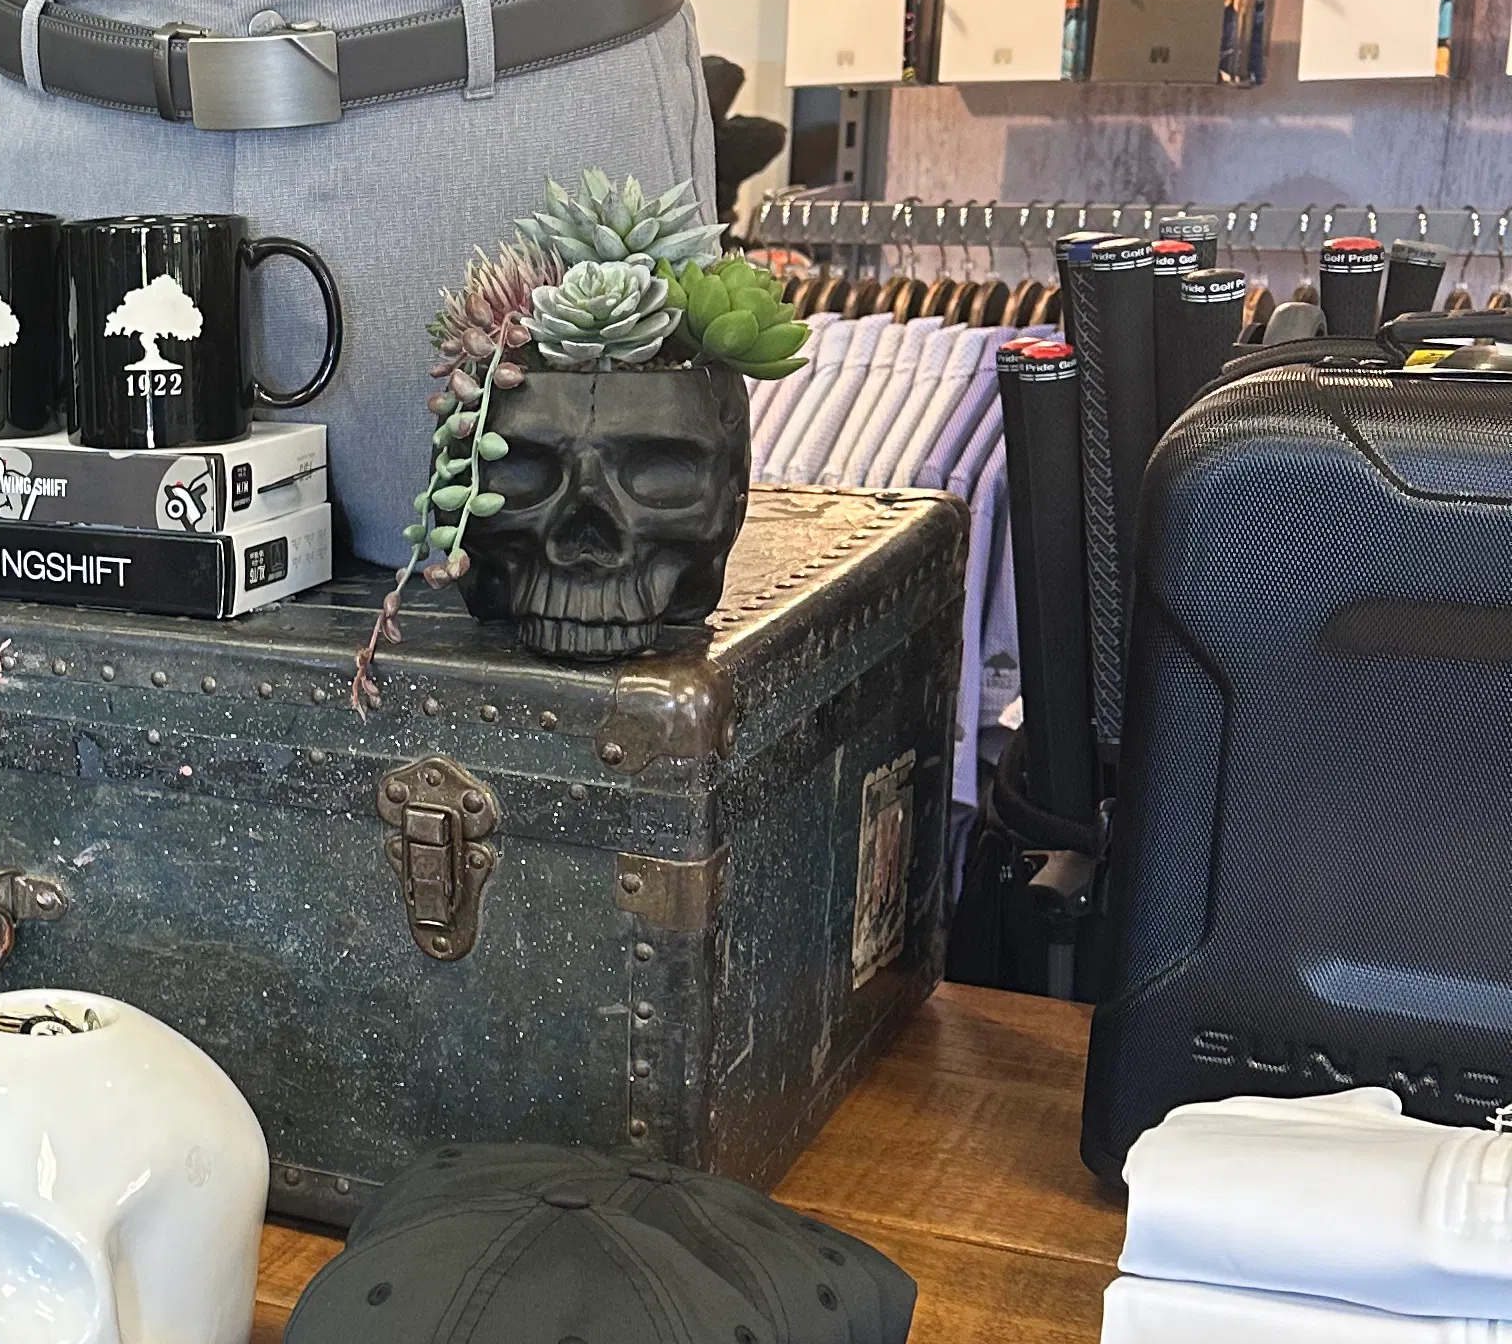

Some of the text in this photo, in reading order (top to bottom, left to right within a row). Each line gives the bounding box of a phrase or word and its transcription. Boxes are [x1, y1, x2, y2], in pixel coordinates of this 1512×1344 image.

[1324, 253, 1379, 263] Golf Pride
[125, 373, 183, 397] 1922
[1192, 1030, 1354, 1086] SUN
